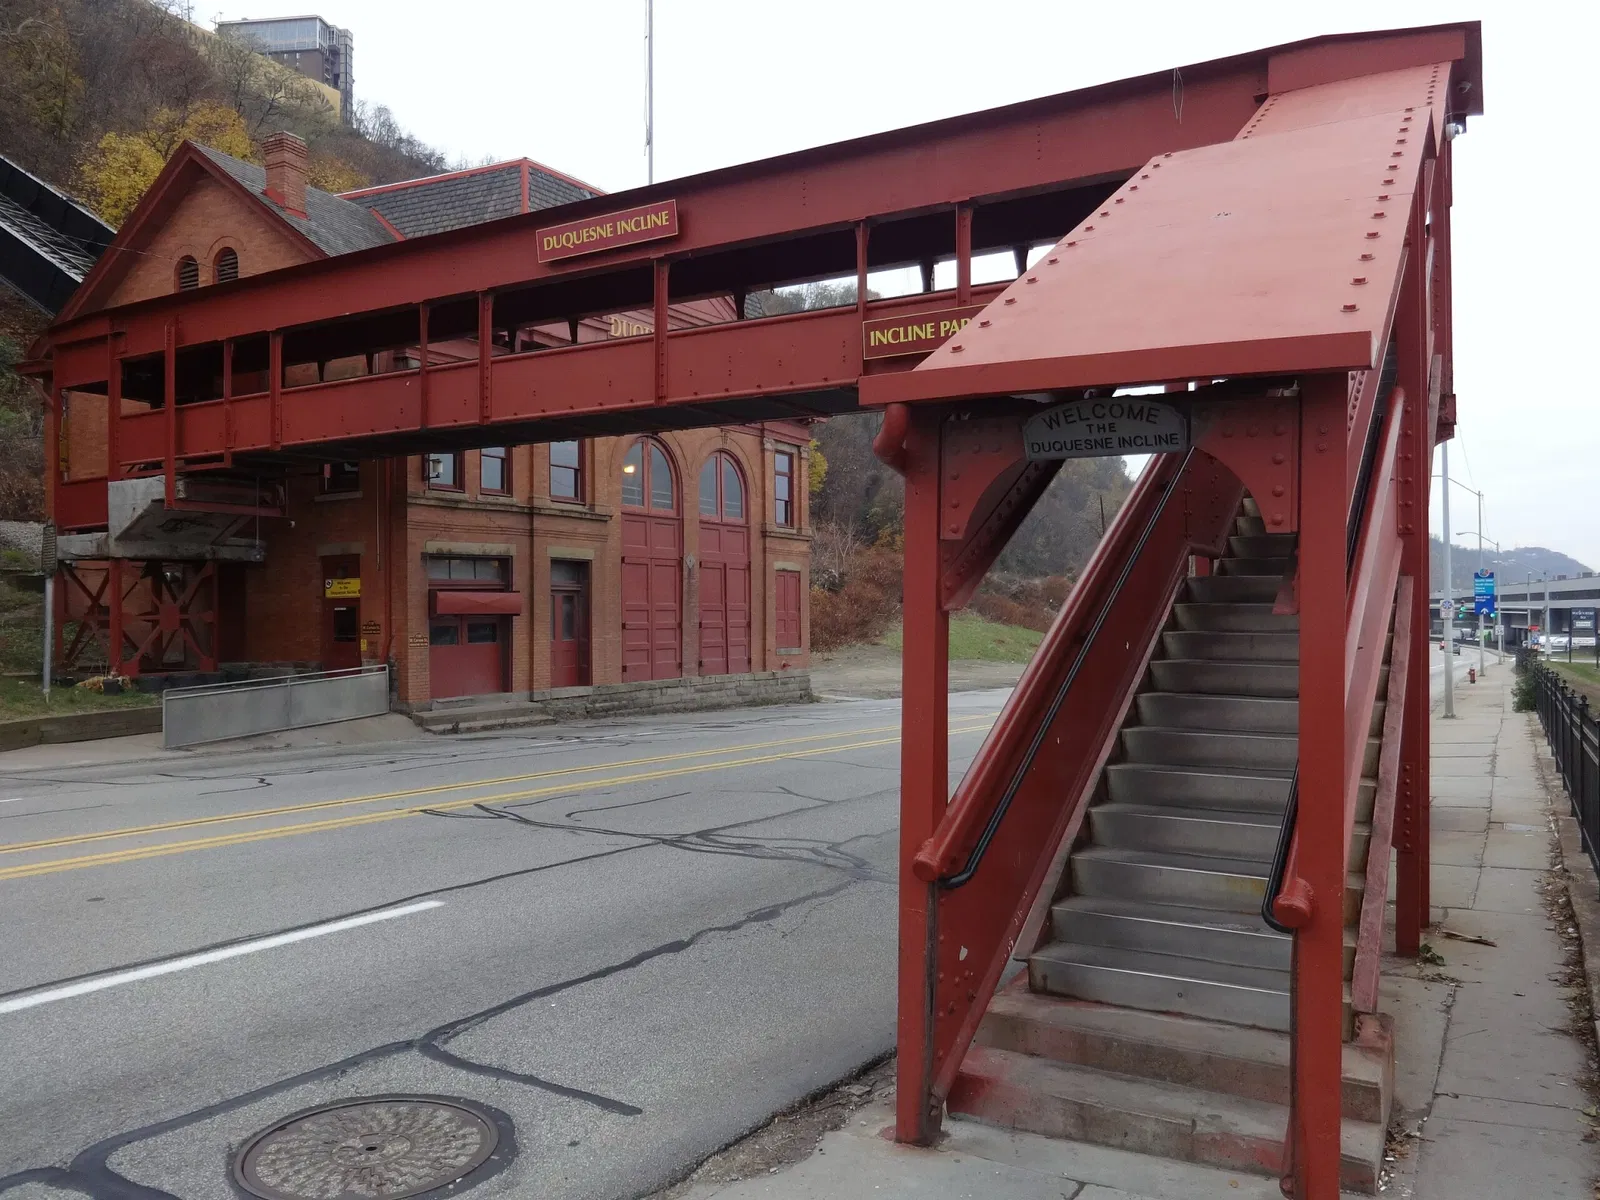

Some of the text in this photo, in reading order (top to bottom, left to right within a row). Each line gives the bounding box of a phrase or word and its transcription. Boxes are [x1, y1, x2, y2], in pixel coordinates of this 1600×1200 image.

[543, 210, 670, 251] DUQUESNE INCLINE
[870, 322, 935, 347] INCLINE
[1042, 402, 1161, 431] WELCOME
[1086, 422, 1118, 434] THE
[1031, 432, 1180, 454] DUQUESNE INCLINE
